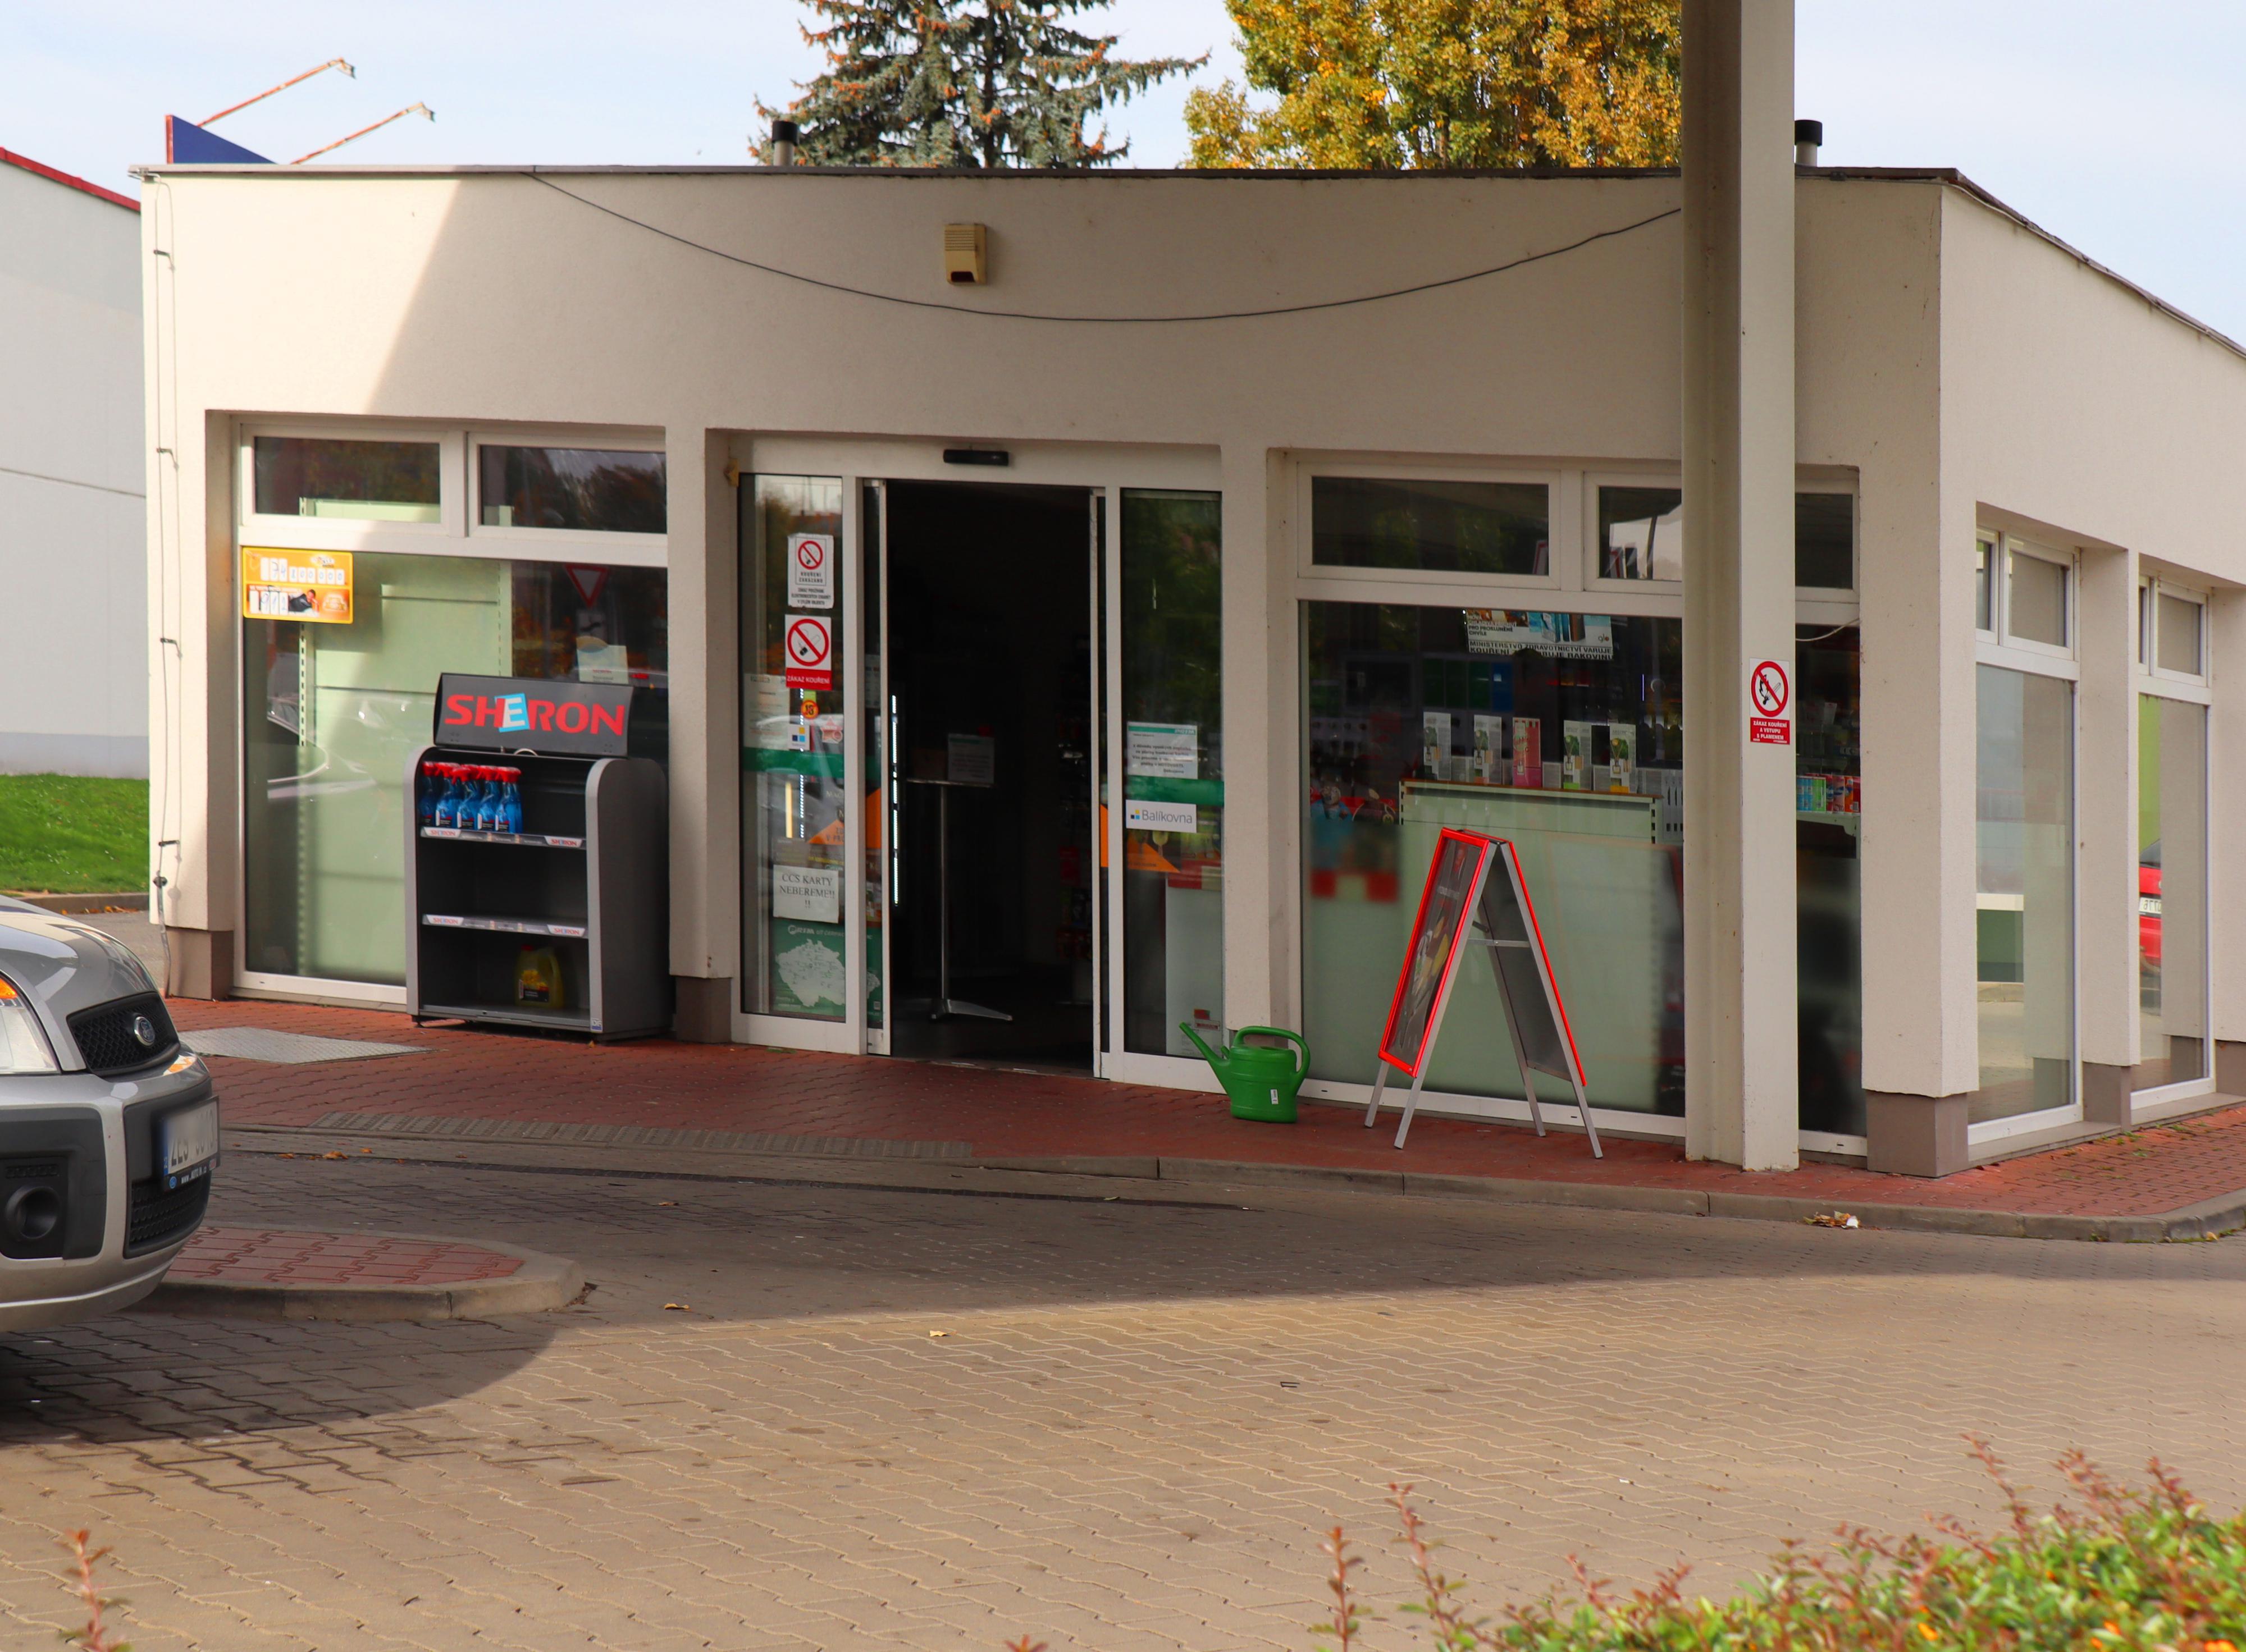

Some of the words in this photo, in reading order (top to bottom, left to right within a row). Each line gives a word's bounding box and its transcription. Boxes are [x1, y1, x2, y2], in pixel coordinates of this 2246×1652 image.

[1469, 640, 1523, 649] MINISTERSTVO
[445, 694, 626, 736] SHERON
[1142, 809, 1193, 824] Balíkovna
[551, 838, 577, 846] SHERON
[782, 873, 800, 883] CCS
[802, 875, 833, 886] KARTY
[779, 884, 835, 899] NEBEREME!!
